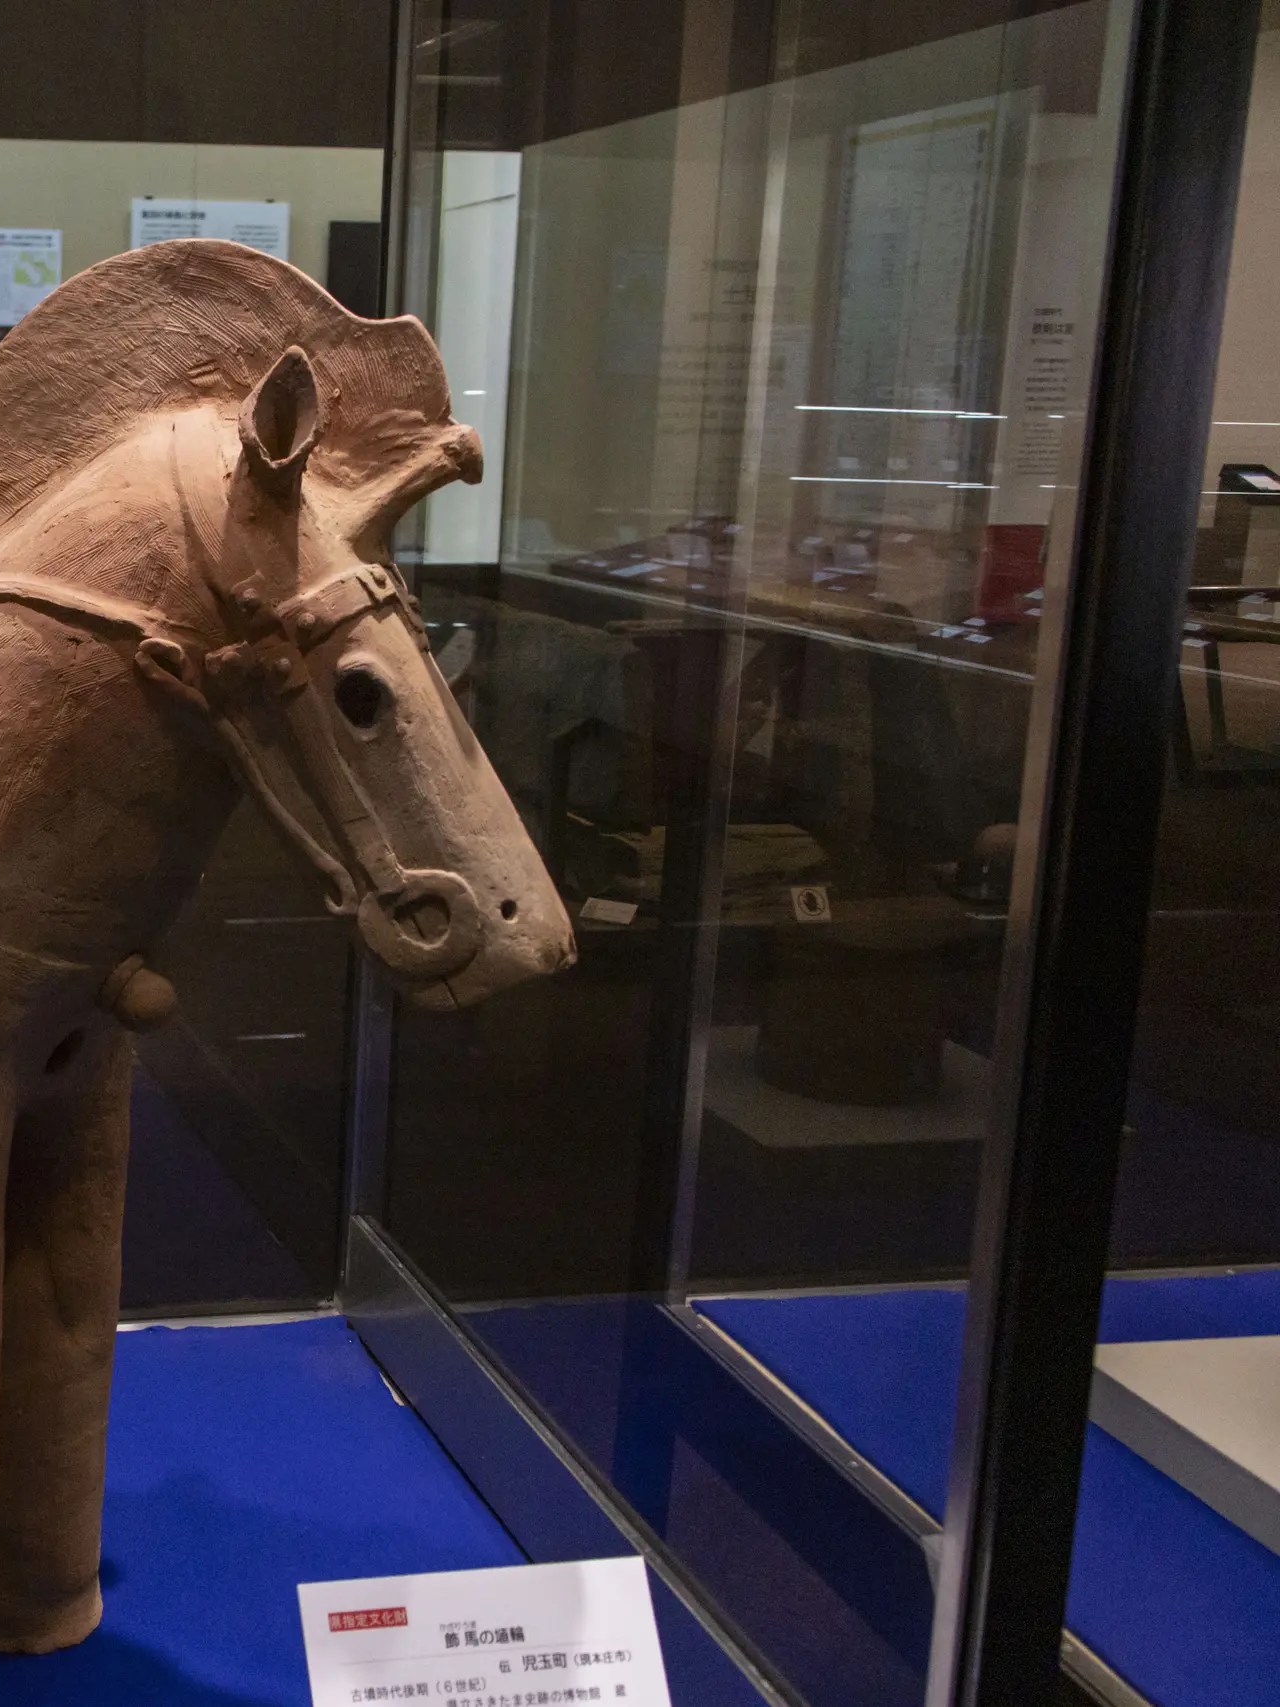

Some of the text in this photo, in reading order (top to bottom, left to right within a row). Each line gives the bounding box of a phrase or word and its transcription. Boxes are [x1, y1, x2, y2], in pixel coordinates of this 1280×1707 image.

[329, 1612, 407, 1630] 県指定文化財
